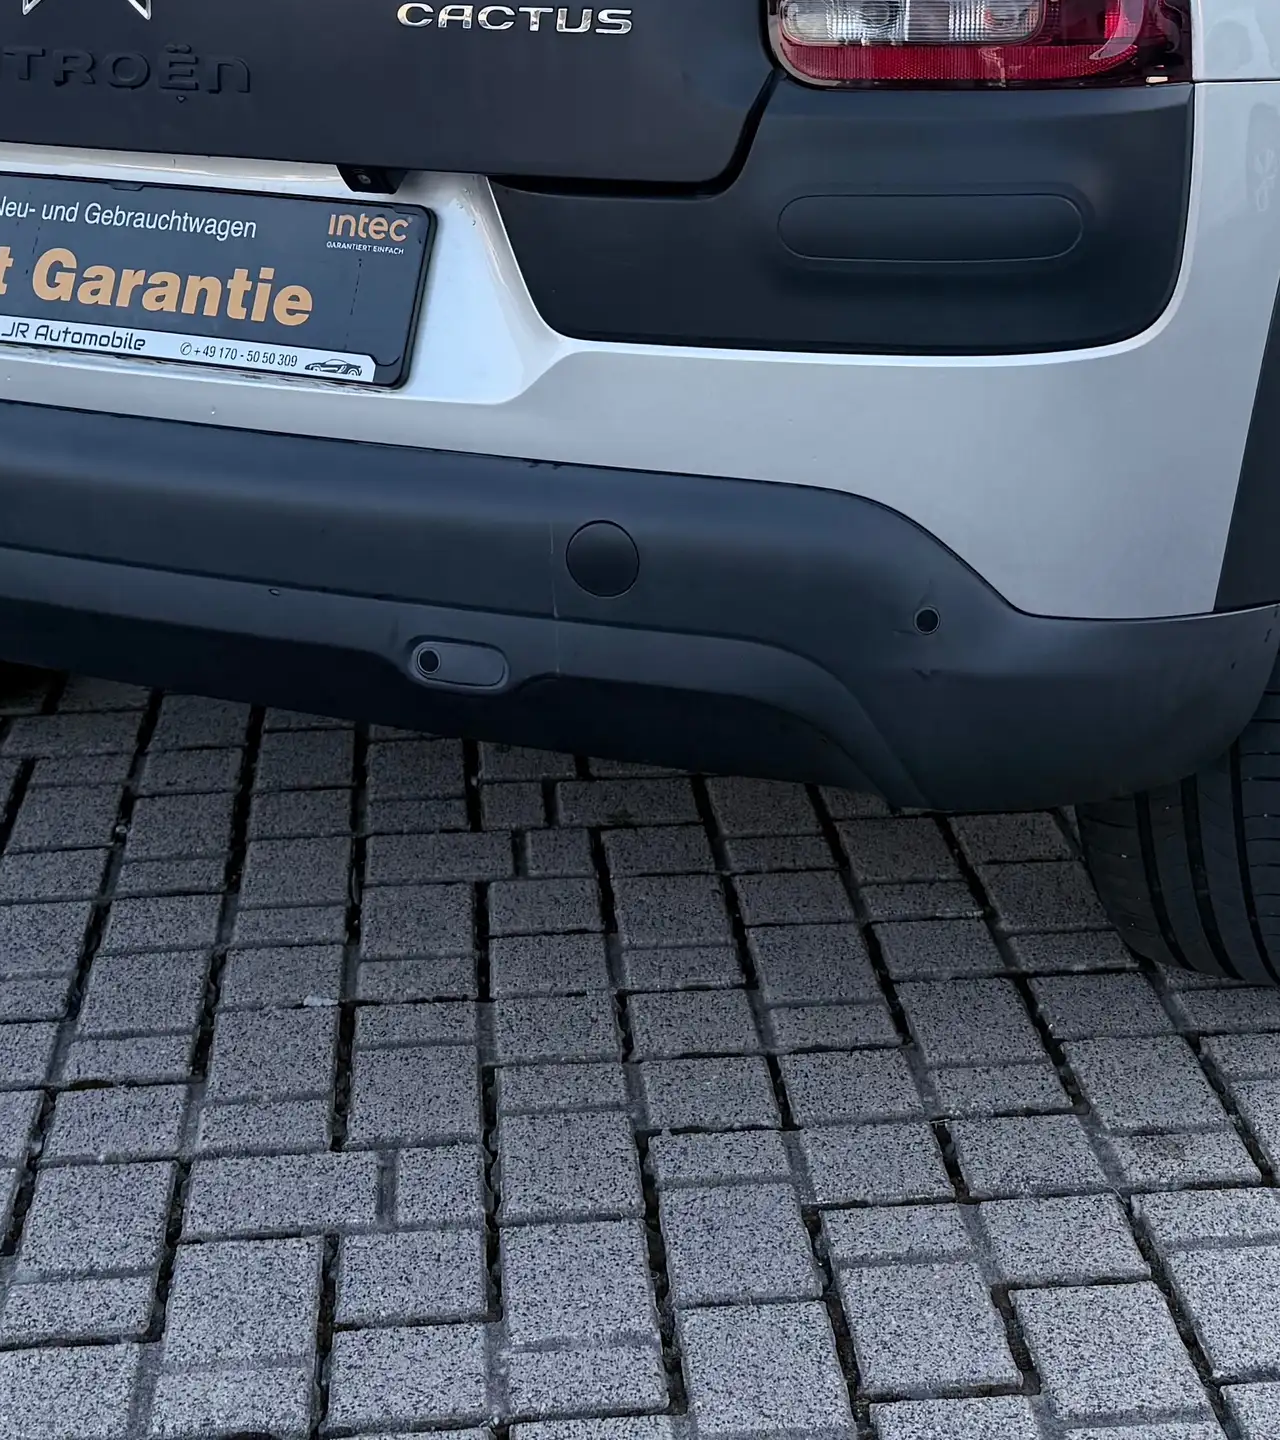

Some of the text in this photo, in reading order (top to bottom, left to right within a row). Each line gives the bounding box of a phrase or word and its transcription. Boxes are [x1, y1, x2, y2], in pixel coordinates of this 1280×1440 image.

[397, 2, 632, 35] CACTUS
[41, 202, 79, 222] und
[84, 202, 257, 241] Gebrauchtwagen
[327, 213, 409, 242] intec
[326, 241, 405, 255] GARANTIERT EINFACH
[32, 247, 313, 327] Garantie
[1, 321, 146, 351] JR Automobile
[219, 346, 238, 360] 170
[277, 353, 298, 367] 309
